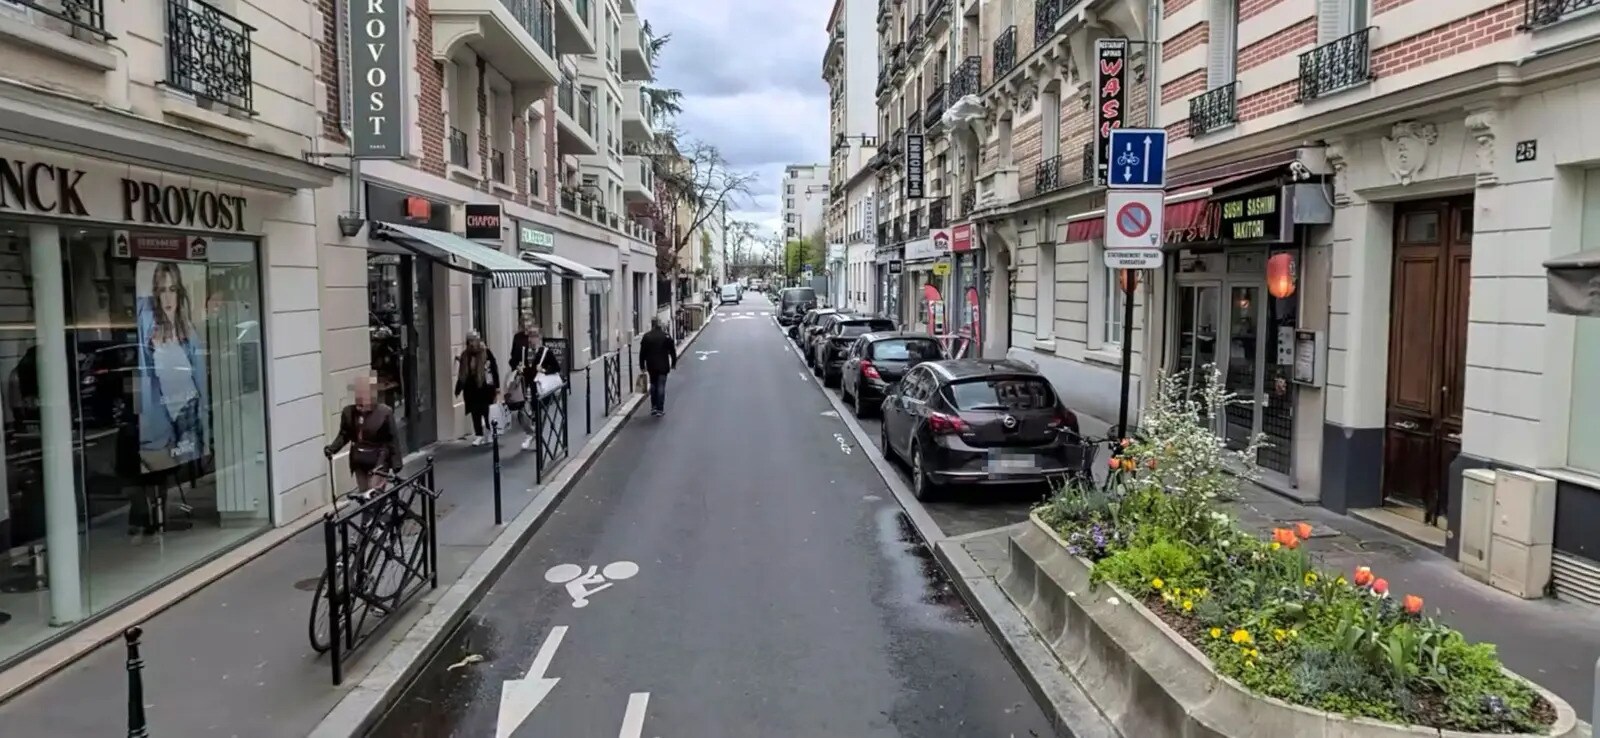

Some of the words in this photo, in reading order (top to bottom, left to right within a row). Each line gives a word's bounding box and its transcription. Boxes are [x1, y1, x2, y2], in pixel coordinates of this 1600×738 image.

[1517, 143, 1534, 160] 25
[121, 178, 247, 232] PROVOST
[1223, 200, 1243, 219] SUSHI
[1247, 195, 1276, 216] SASHIMI
[467, 215, 499, 227] CHAPON
[1233, 220, 1264, 239] YAKITORI
